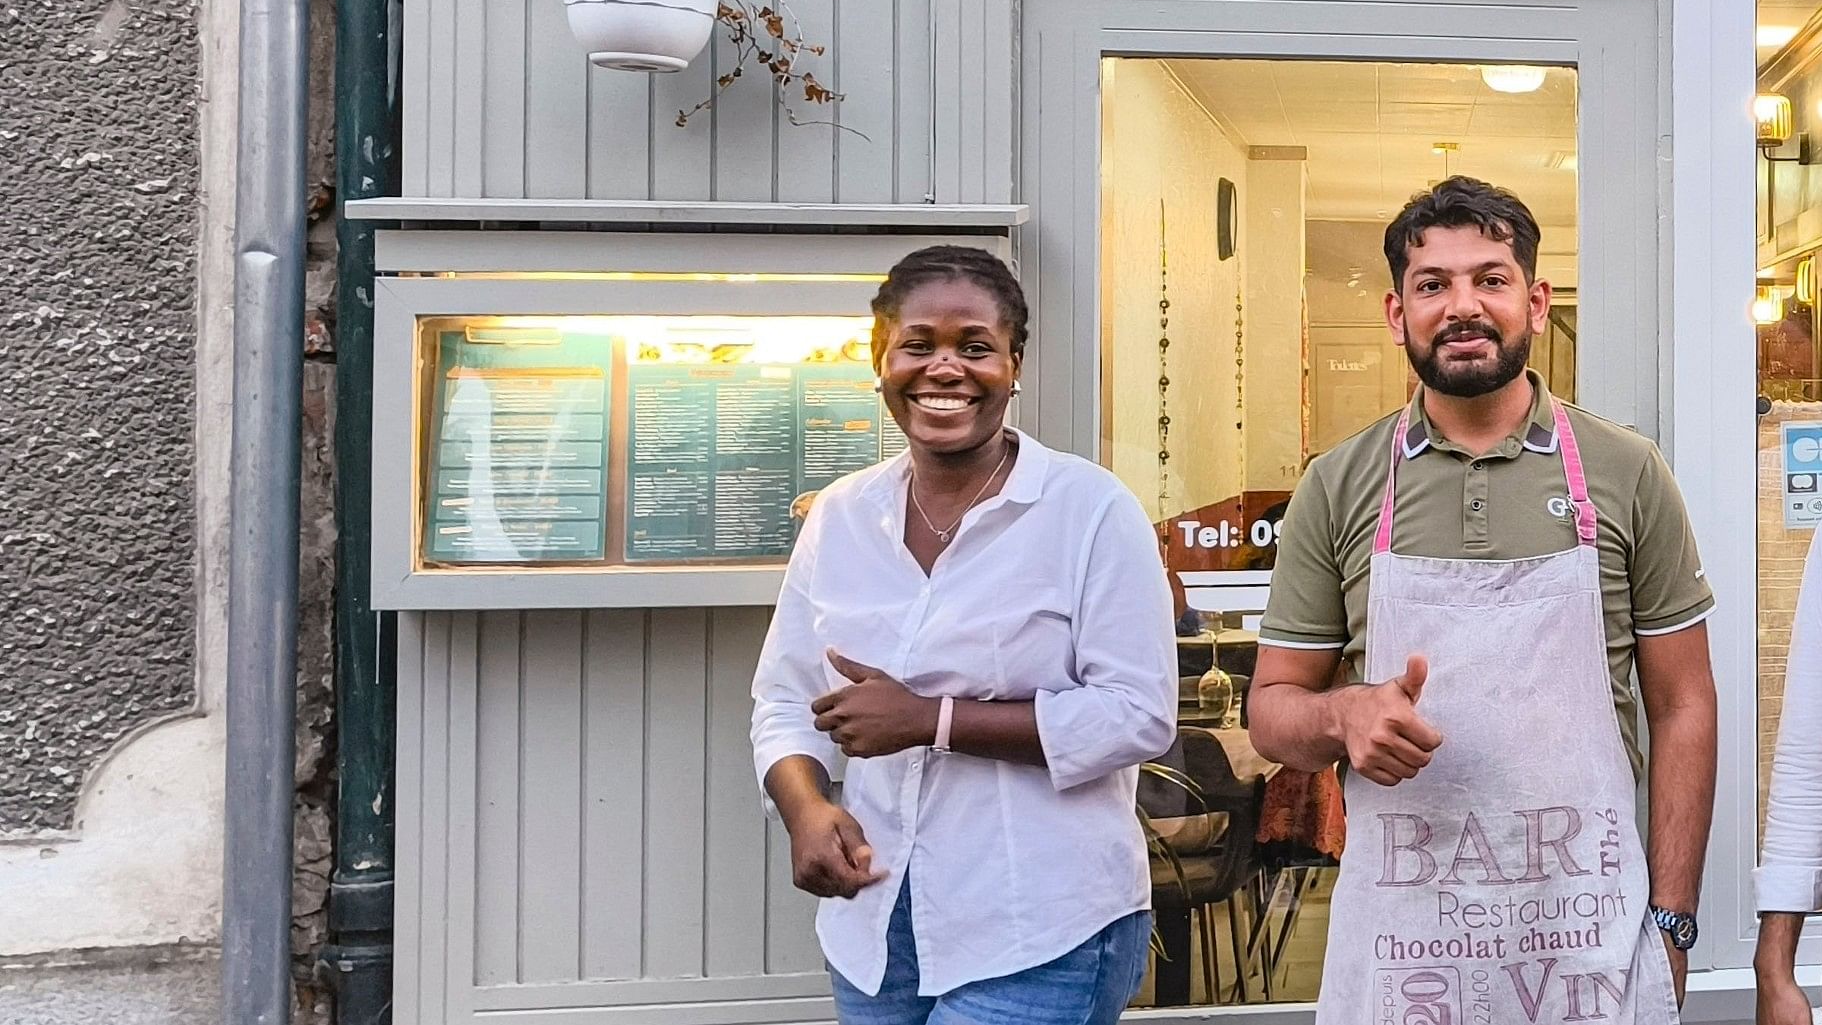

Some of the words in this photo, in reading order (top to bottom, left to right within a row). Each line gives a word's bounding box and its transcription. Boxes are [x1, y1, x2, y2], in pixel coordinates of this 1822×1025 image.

[1177, 519, 1239, 548] Tel:
[1375, 805, 1593, 888] BAR
[1595, 807, 1622, 878] Thé
[1437, 888, 1627, 929] Restaurant
[1374, 933, 1507, 960] Chocolat
[1518, 922, 1602, 955] chaud
